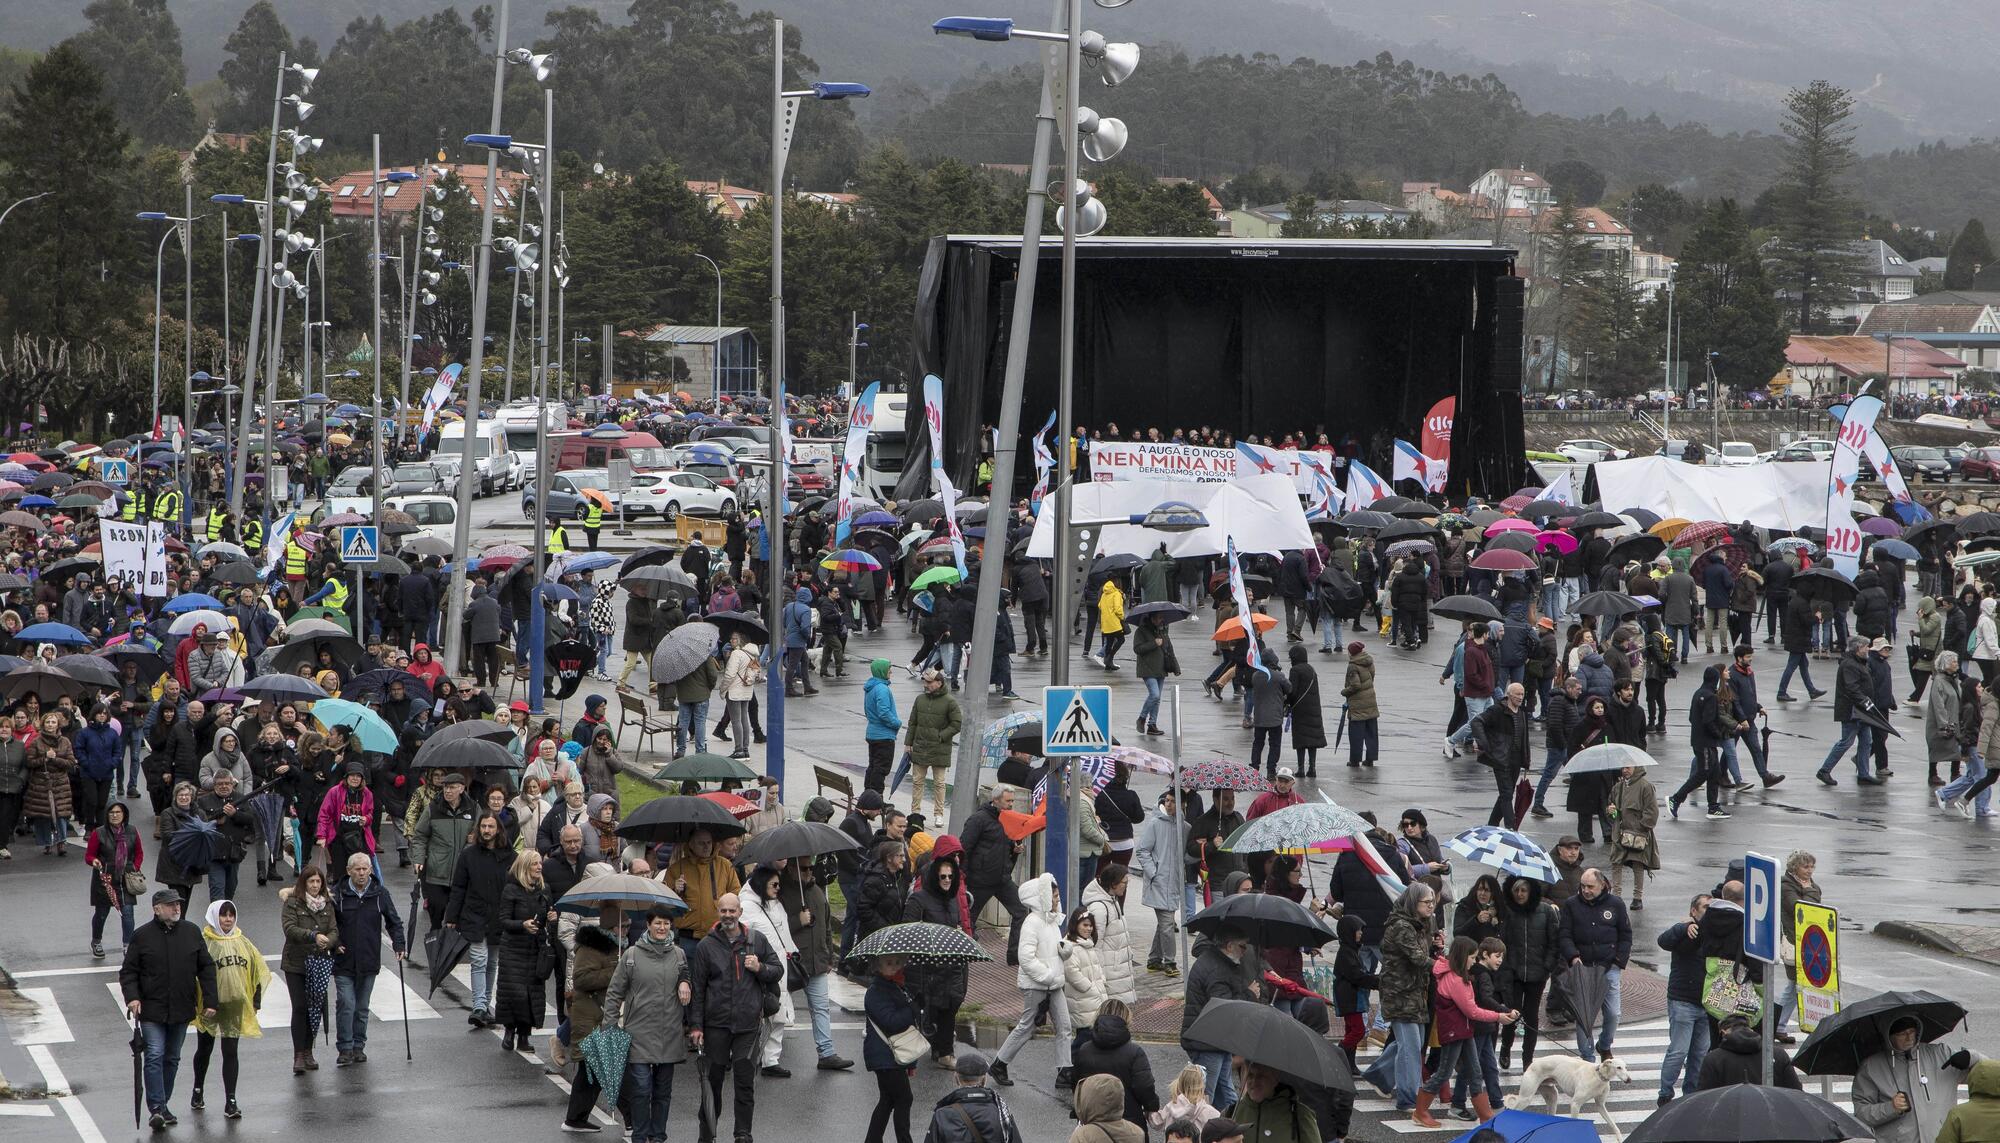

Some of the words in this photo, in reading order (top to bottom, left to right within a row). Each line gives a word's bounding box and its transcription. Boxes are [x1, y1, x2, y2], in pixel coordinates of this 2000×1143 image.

[1138, 445, 1147, 453] A
[1149, 446, 1180, 455] AUGA
[1192, 448, 1200, 457] O
[1203, 449, 1234, 458] NOSO
[1097, 452, 1143, 466] NEN
[1151, 454, 1208, 470] MINA
[1213, 459, 1236, 471] NE
[1139, 466, 1194, 476] DEFENDAMOS
[1749, 867, 1769, 945] P
